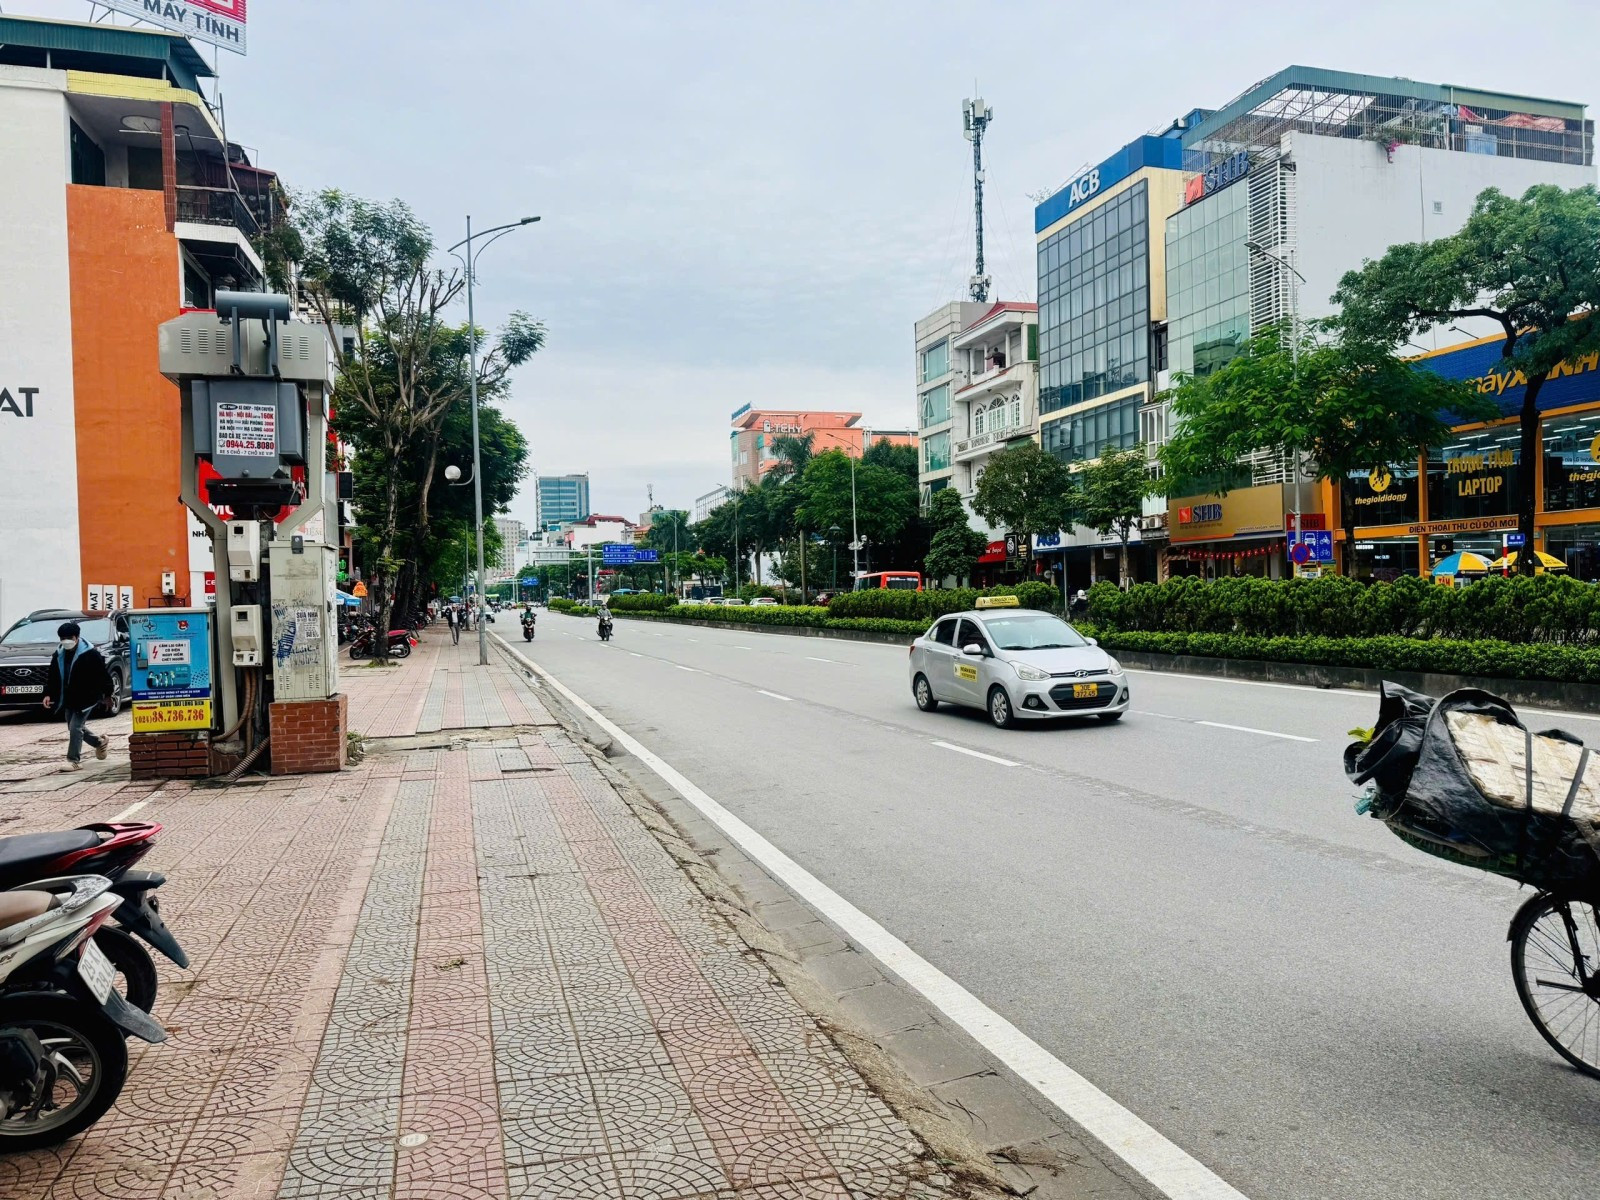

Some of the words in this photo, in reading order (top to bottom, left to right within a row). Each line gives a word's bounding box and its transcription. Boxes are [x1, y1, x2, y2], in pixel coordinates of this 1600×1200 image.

[193, 11, 239, 42] TÍNH
[1204, 150, 1248, 192] SHB
[1069, 168, 1100, 208] ACB
[226, 440, 274, 449] 0944.25.8080
[1459, 476, 1502, 496] LAPTOP
[1355, 493, 1407, 505] thegioididong
[1193, 504, 1222, 522] SHB
[1428, 524, 1450, 532] THOẠI
[1452, 522, 1468, 530] THU
